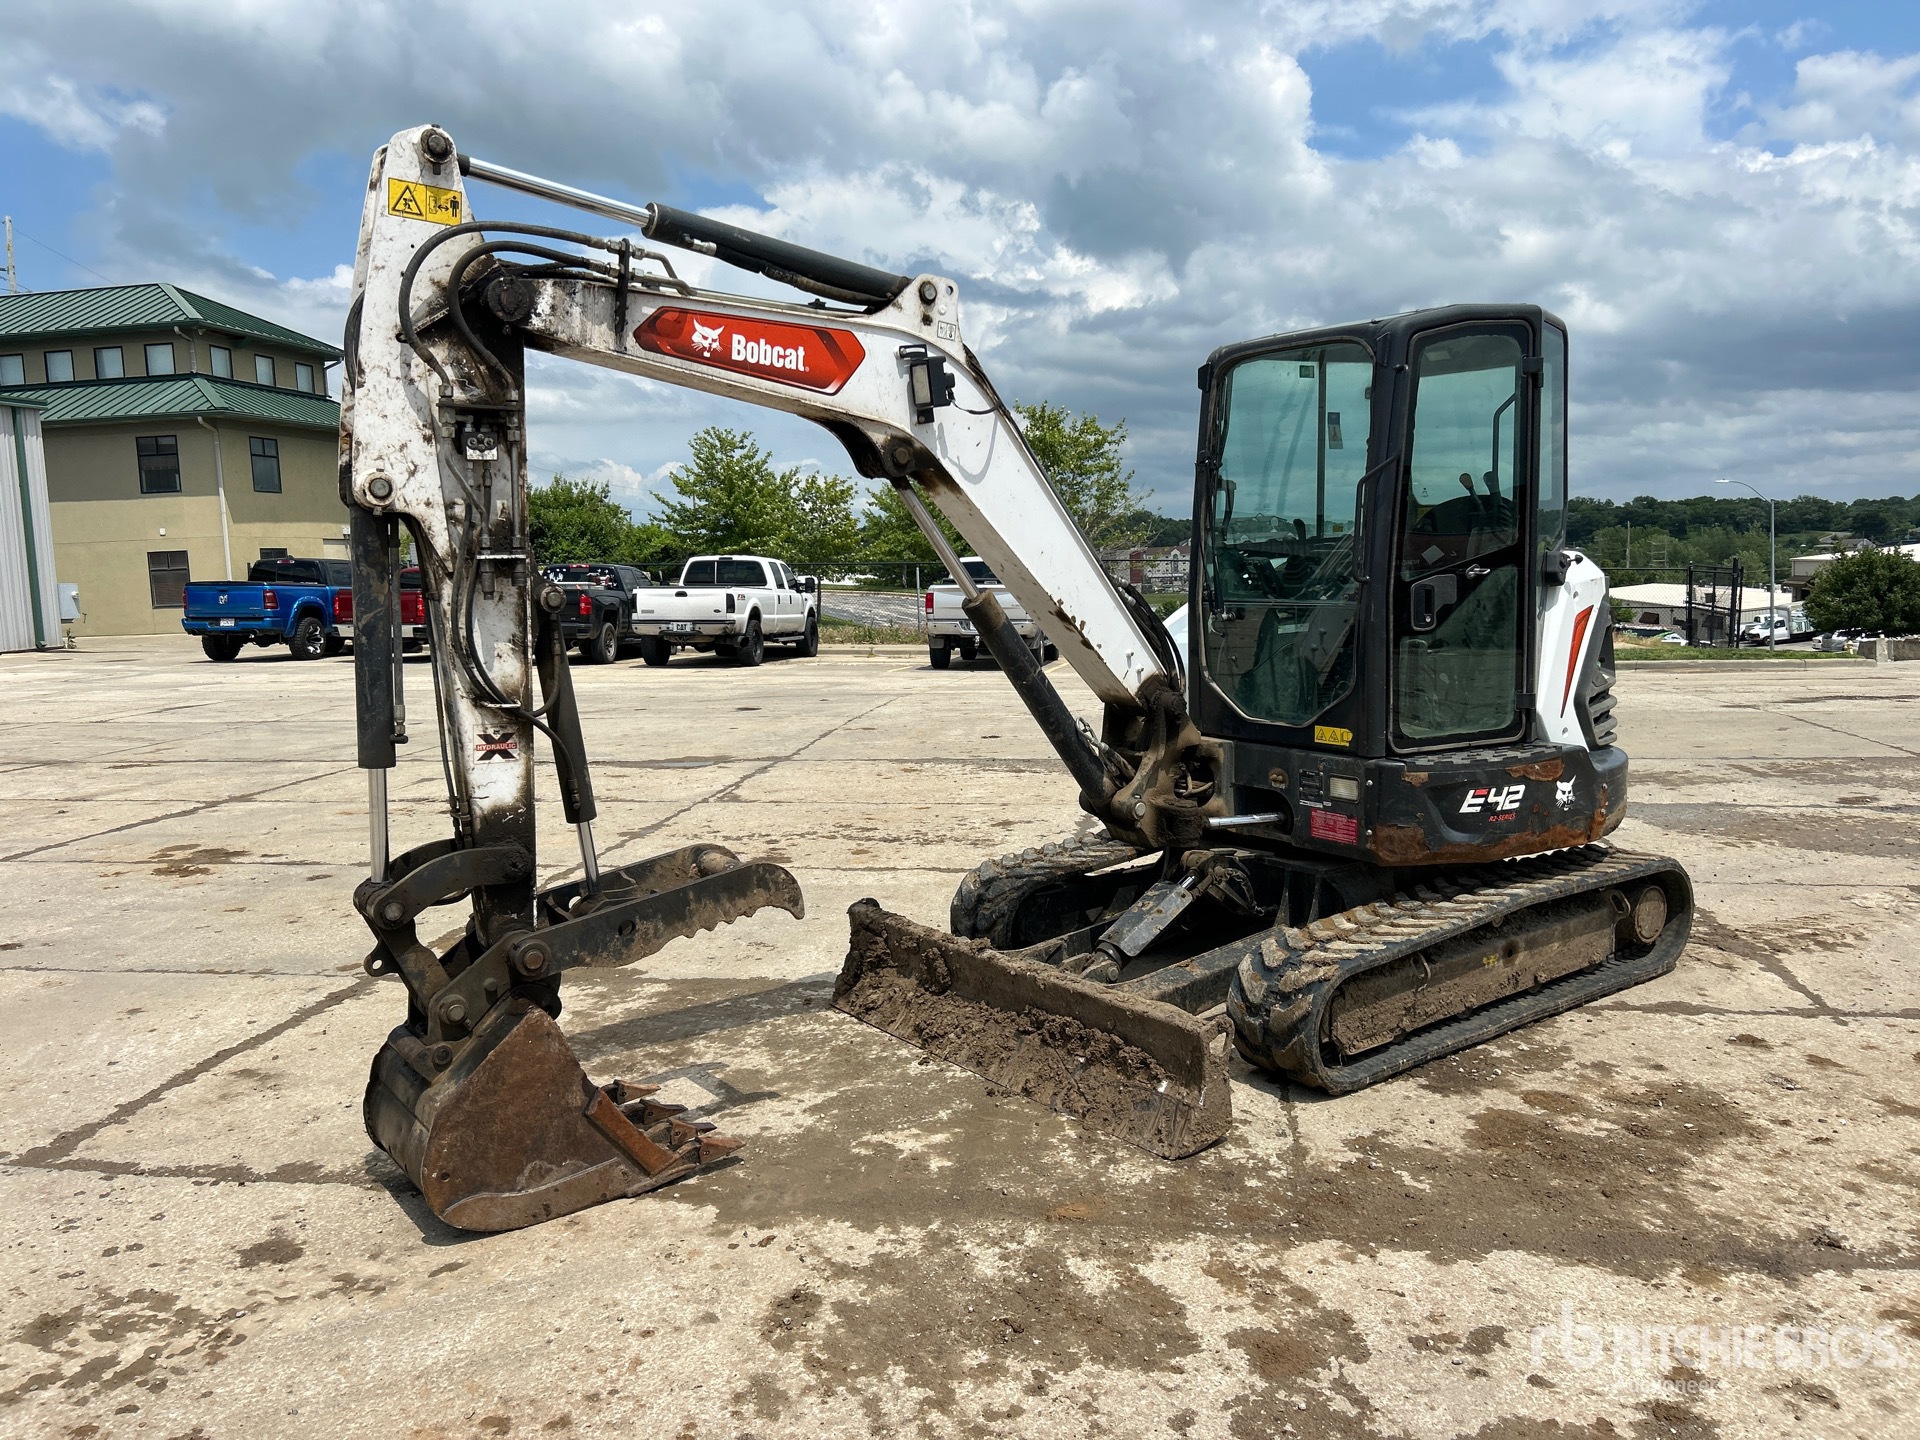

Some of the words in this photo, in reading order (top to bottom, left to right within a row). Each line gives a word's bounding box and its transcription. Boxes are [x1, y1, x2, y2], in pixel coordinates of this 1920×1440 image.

[731, 332, 805, 372] Bobcat
[676, 623, 688, 631] CAT
[477, 743, 516, 751] HYDRAULIC
[1458, 784, 1526, 813] E42
